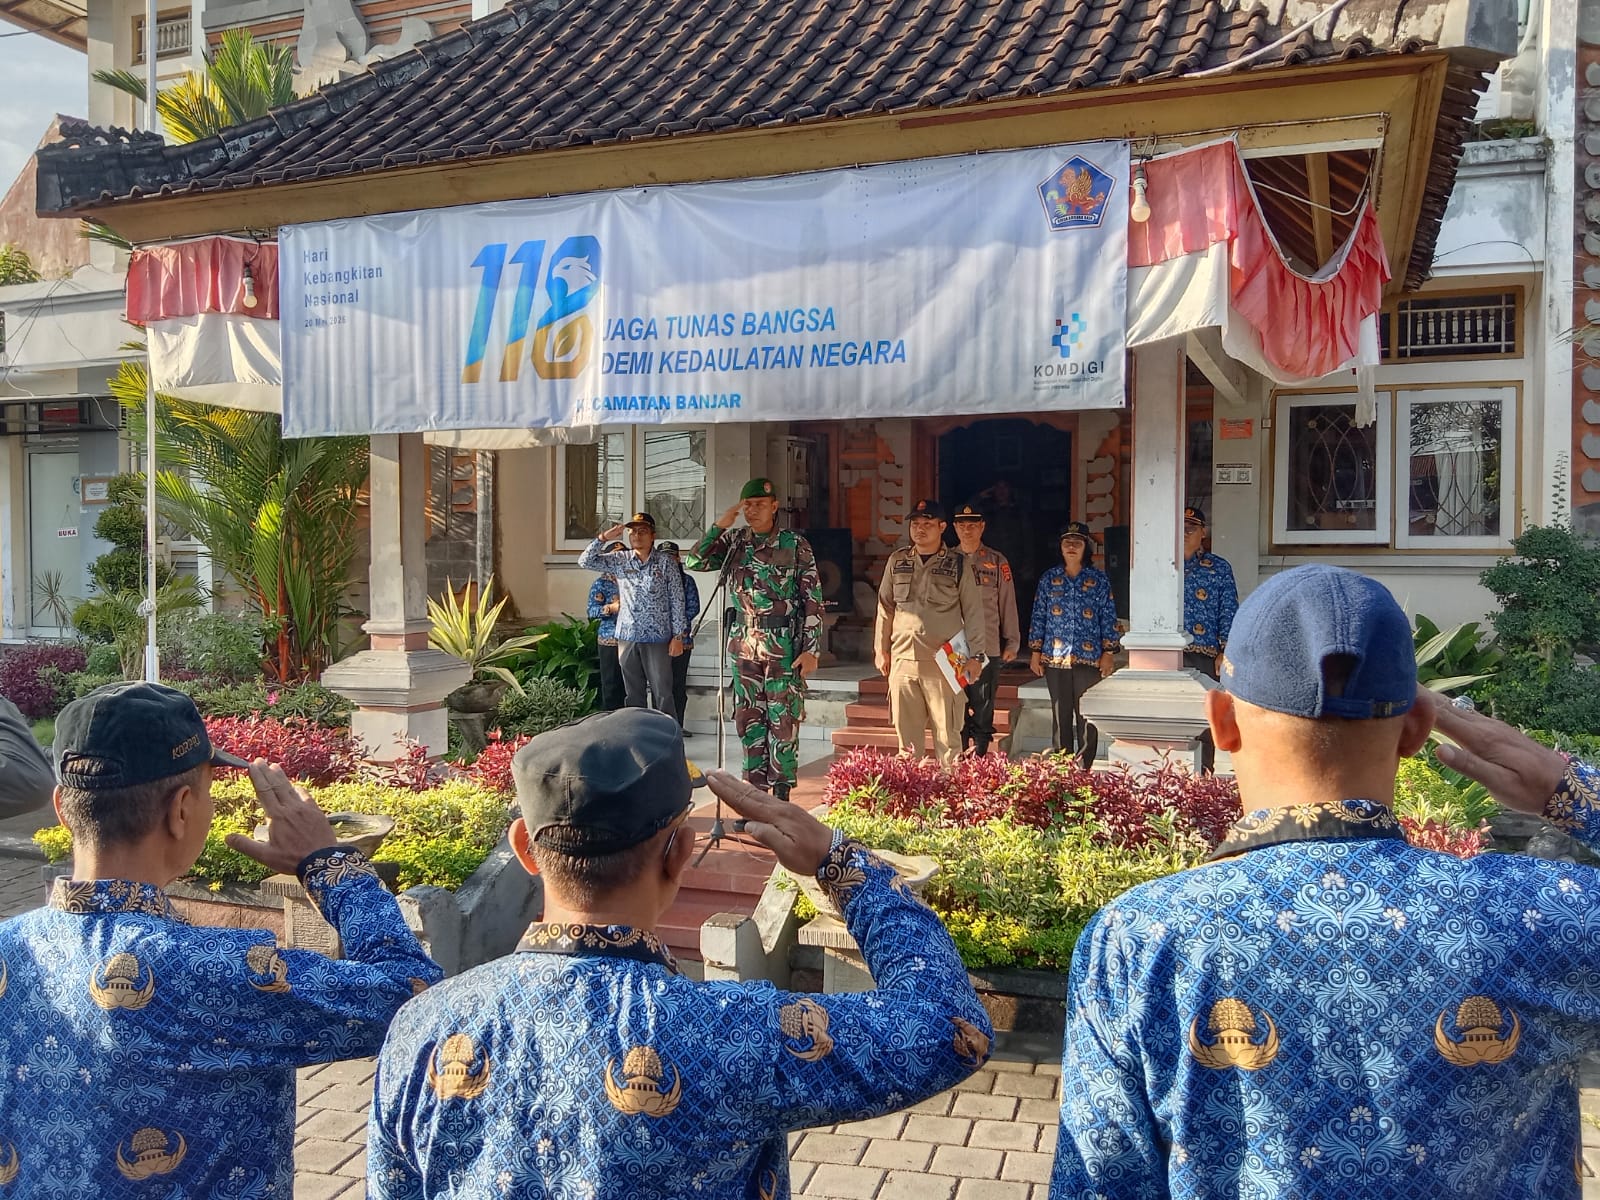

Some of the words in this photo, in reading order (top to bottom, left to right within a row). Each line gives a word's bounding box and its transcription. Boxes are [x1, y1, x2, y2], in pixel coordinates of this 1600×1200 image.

[303, 247, 329, 264] Hari
[303, 265, 383, 286] Kebangkitan
[303, 288, 359, 308] Nasional
[461, 235, 602, 384] 118
[603, 317, 658, 342] JAGA
[667, 312, 735, 339] TUNAS
[741, 306, 836, 336] BANGSA
[602, 351, 654, 375] DEMI
[658, 345, 809, 375] KEDAULATAN
[809, 339, 907, 368] NEGARA
[1033, 360, 1104, 378] KOMDIGI
[576, 396, 671, 412] KCAMATAN
[676, 393, 742, 410] BANJAR
[58, 529, 77, 537] BUKA
